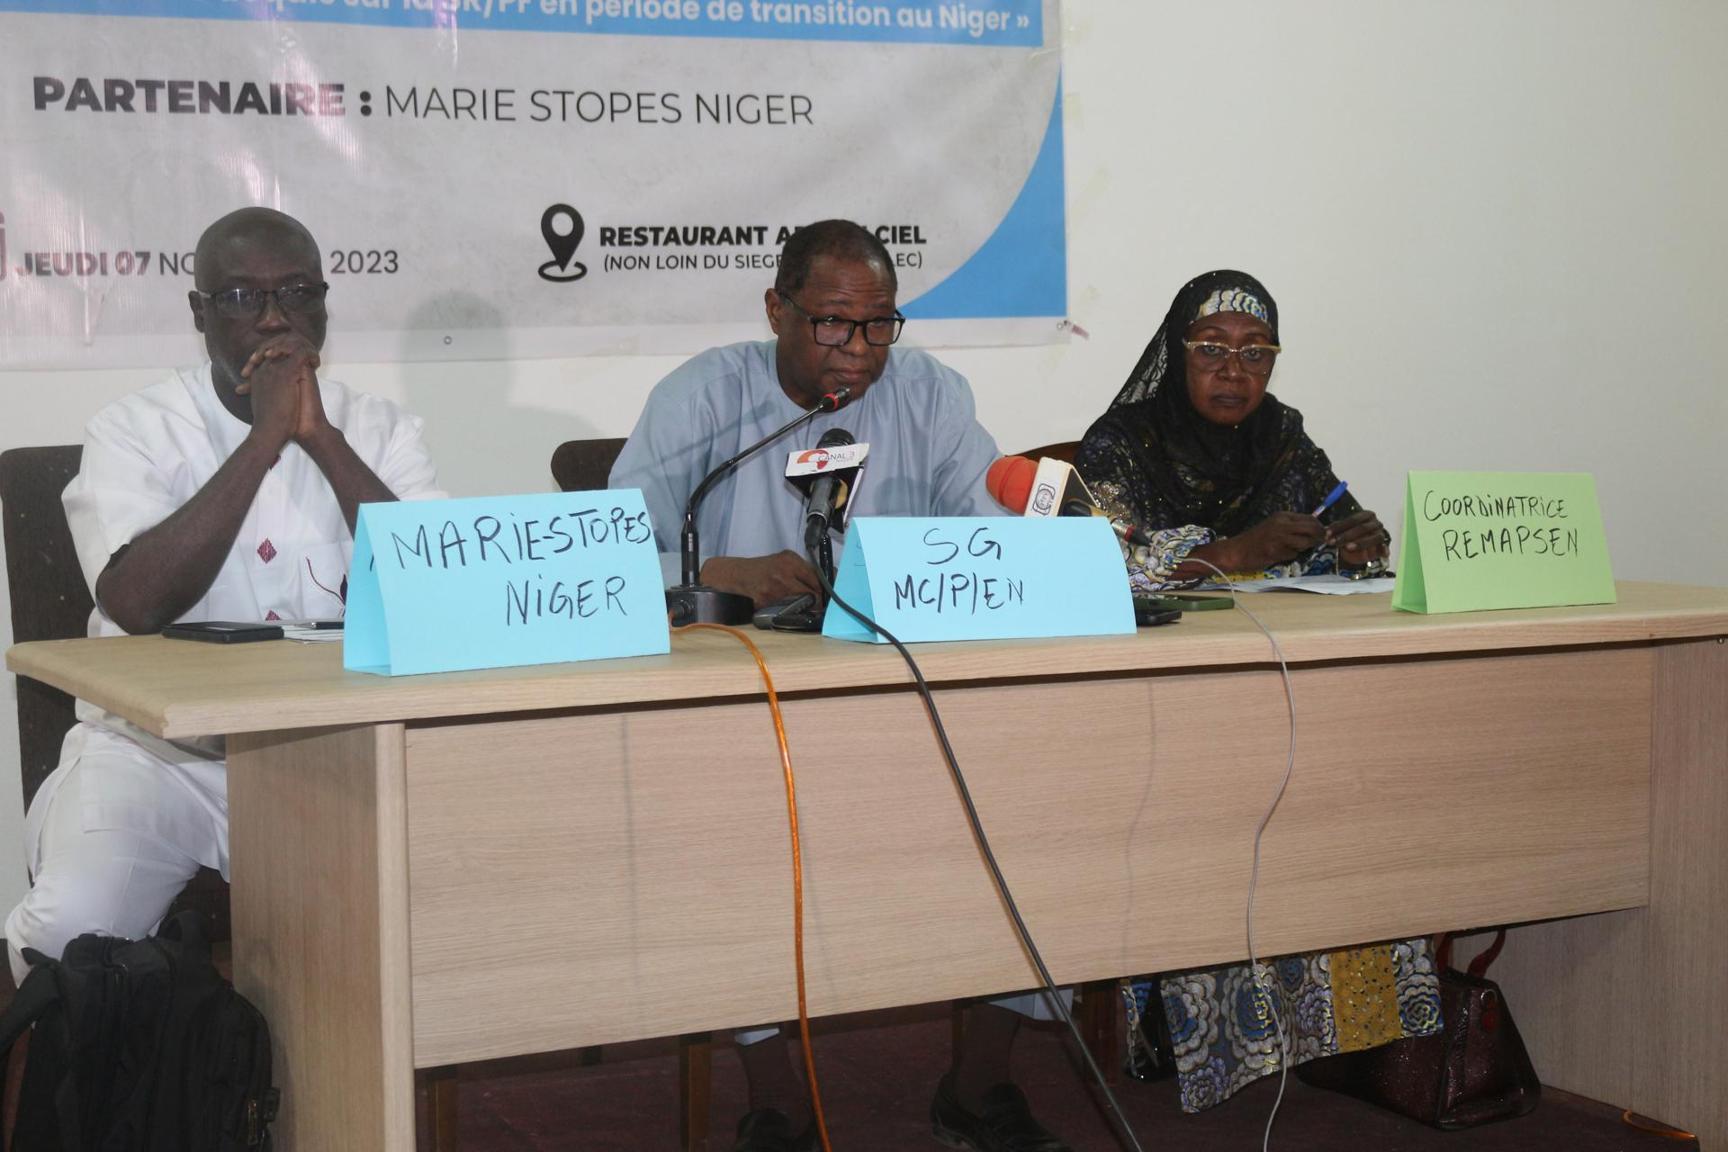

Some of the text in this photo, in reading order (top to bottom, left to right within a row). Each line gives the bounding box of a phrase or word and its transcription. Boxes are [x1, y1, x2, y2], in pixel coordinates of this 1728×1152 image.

[540, 0, 578, 16] en
[706, 0, 744, 22] de
[751, 0, 891, 27] transition
[897, 9, 933, 28] au
[939, 4, 1010, 38] Niger
[33, 76, 345, 117] PARTENAIRE
[386, 86, 516, 121] MARIE
[529, 90, 682, 123] STOPES
[695, 94, 813, 125] NIGER
[600, 225, 768, 246] RESTAURANT
[15, 252, 108, 276] JEUDI
[115, 251, 151, 276] 07
[330, 250, 399, 275] 2023
[604, 254, 650, 273] (NON
[656, 255, 698, 270] LOIN
[704, 254, 729, 270] DU
[923, 527, 1002, 565] SG
[1442, 525, 1579, 562] REMAPSEN
